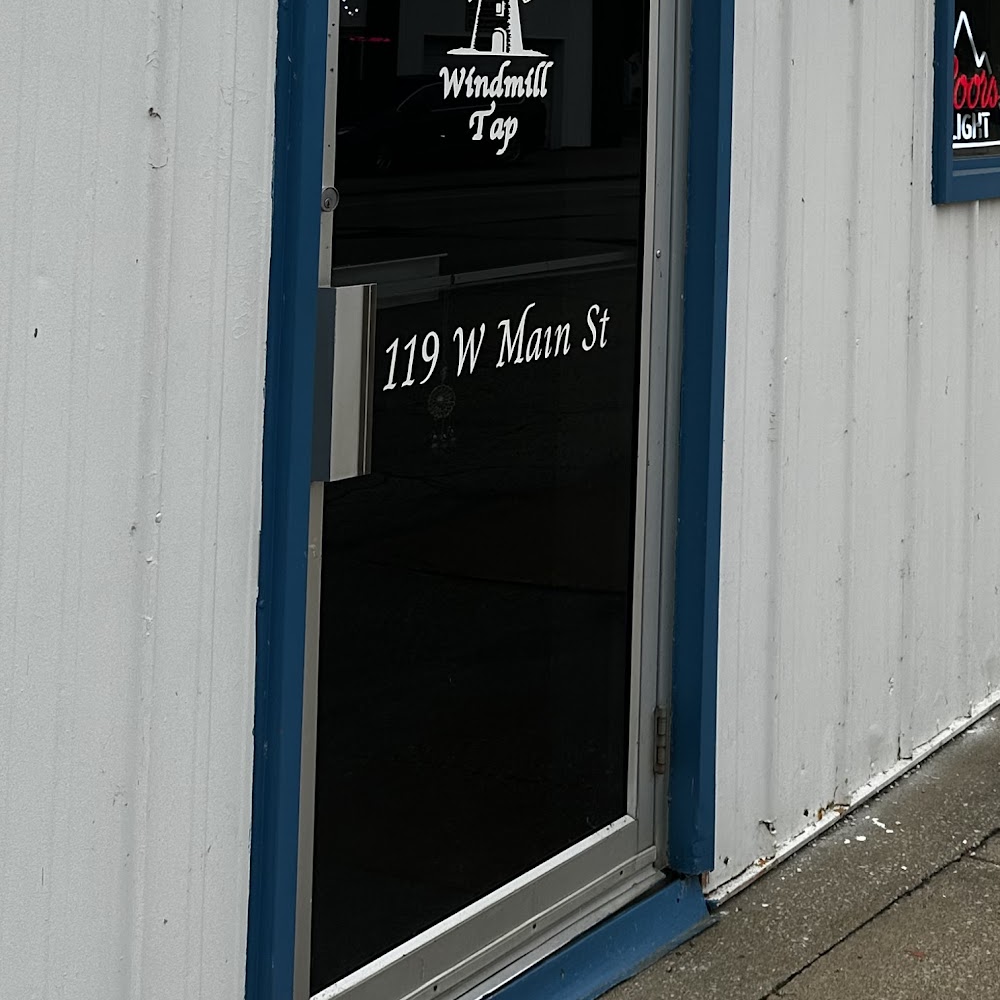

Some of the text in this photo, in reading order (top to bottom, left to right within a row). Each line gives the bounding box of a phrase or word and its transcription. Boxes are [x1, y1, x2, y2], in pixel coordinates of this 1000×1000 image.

[438, 60, 554, 100] Windmill
[469, 100, 519, 156] Tap
[382, 302, 611, 391] 119 W Main St
